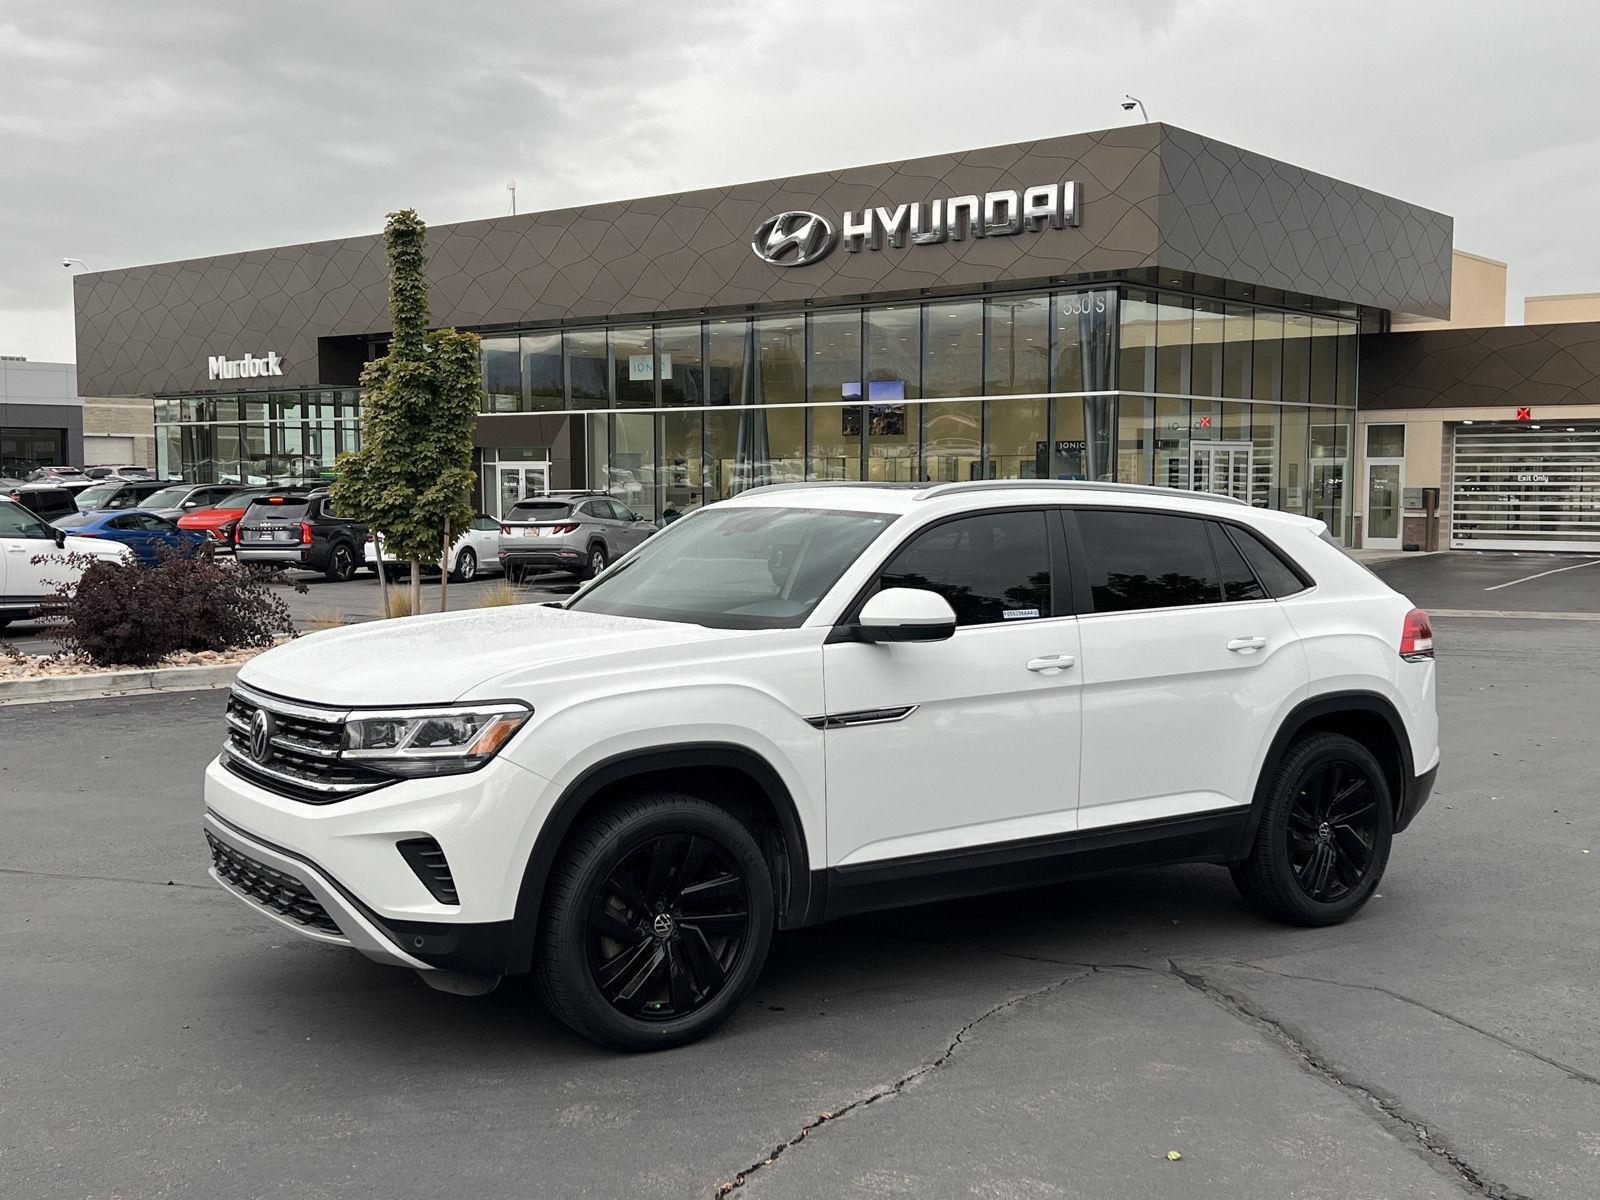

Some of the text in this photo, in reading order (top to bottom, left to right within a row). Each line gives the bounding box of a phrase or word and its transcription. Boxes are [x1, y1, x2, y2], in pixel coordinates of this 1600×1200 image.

[843, 180, 1082, 253] HYUNDAI
[1095, 296, 1105, 313] S
[208, 351, 283, 380] Murdock
[1517, 473, 1549, 483] Exit Only
